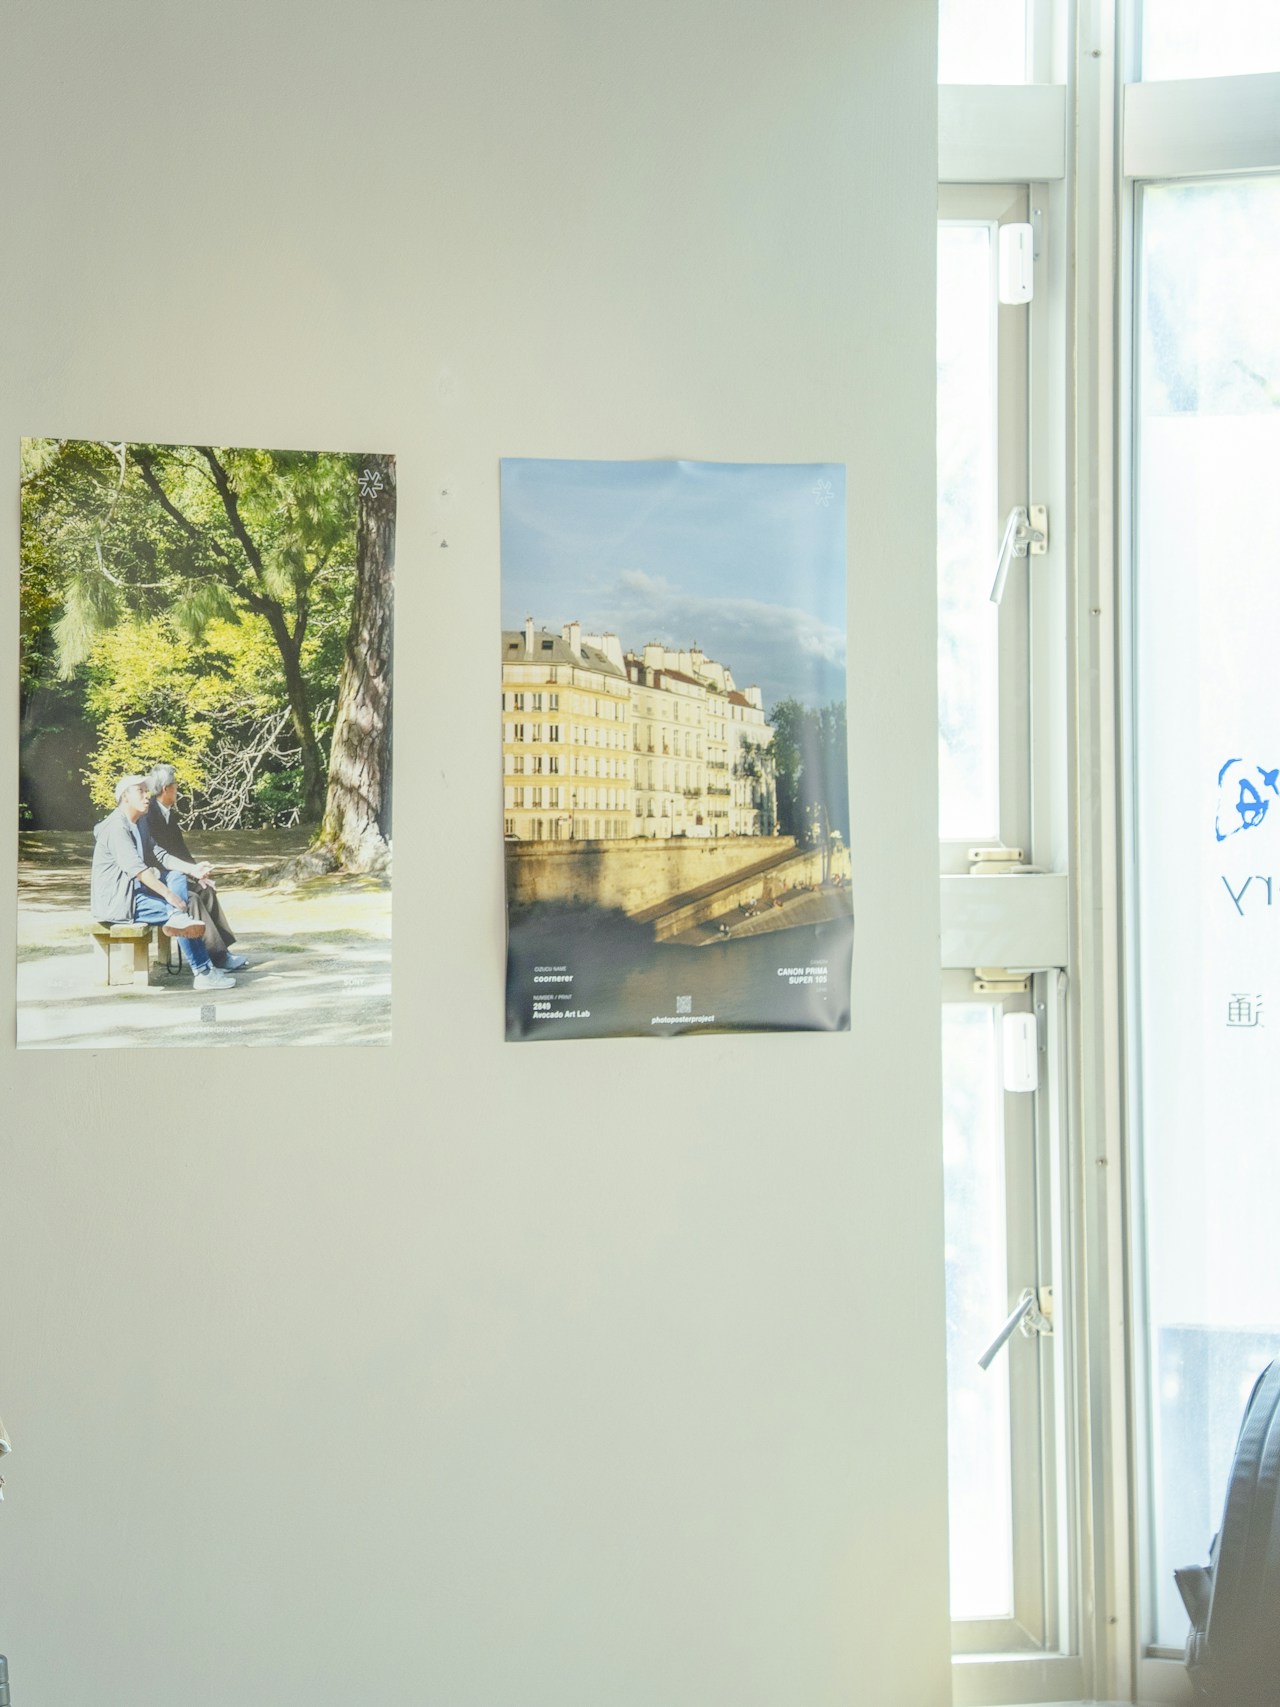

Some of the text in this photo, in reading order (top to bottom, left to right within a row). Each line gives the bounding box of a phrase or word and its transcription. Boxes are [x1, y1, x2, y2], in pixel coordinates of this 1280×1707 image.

[777, 966, 828, 977] CANON PRIMA
[788, 975, 813, 985] SUPER
[532, 1010, 591, 1019] Avocado Art Lab
